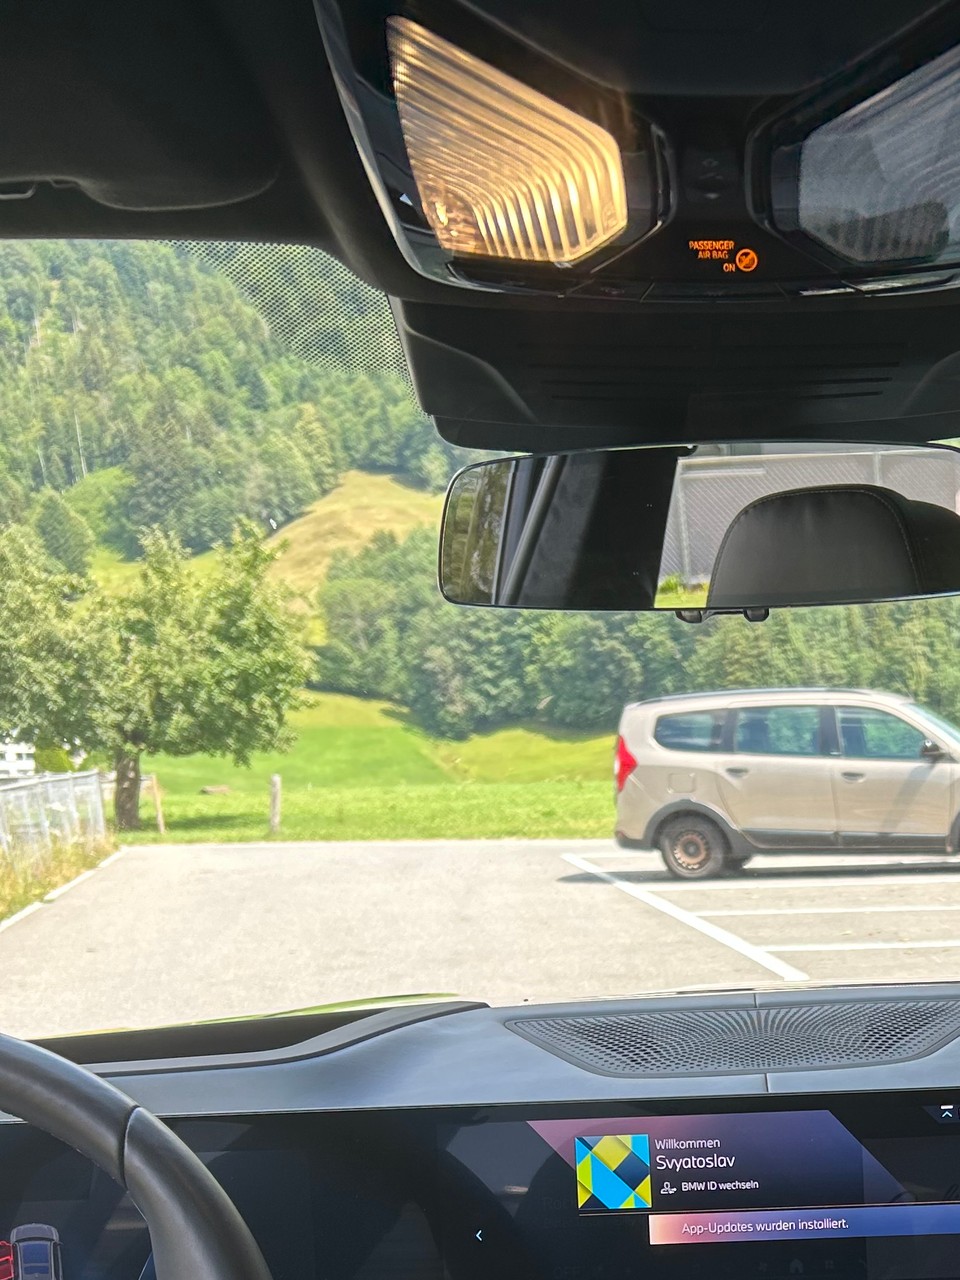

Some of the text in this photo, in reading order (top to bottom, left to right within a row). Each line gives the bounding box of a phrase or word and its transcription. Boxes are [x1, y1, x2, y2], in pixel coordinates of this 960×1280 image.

[688, 240, 735, 250] PASSENGER
[722, 263, 736, 272] ON
[655, 1136, 721, 1151] Willkommen
[655, 1154, 736, 1173] Svyatoslav
[681, 1179, 759, 1192] BMW ID wechseln
[681, 1217, 849, 1236] App-Updates wurden installiert.
